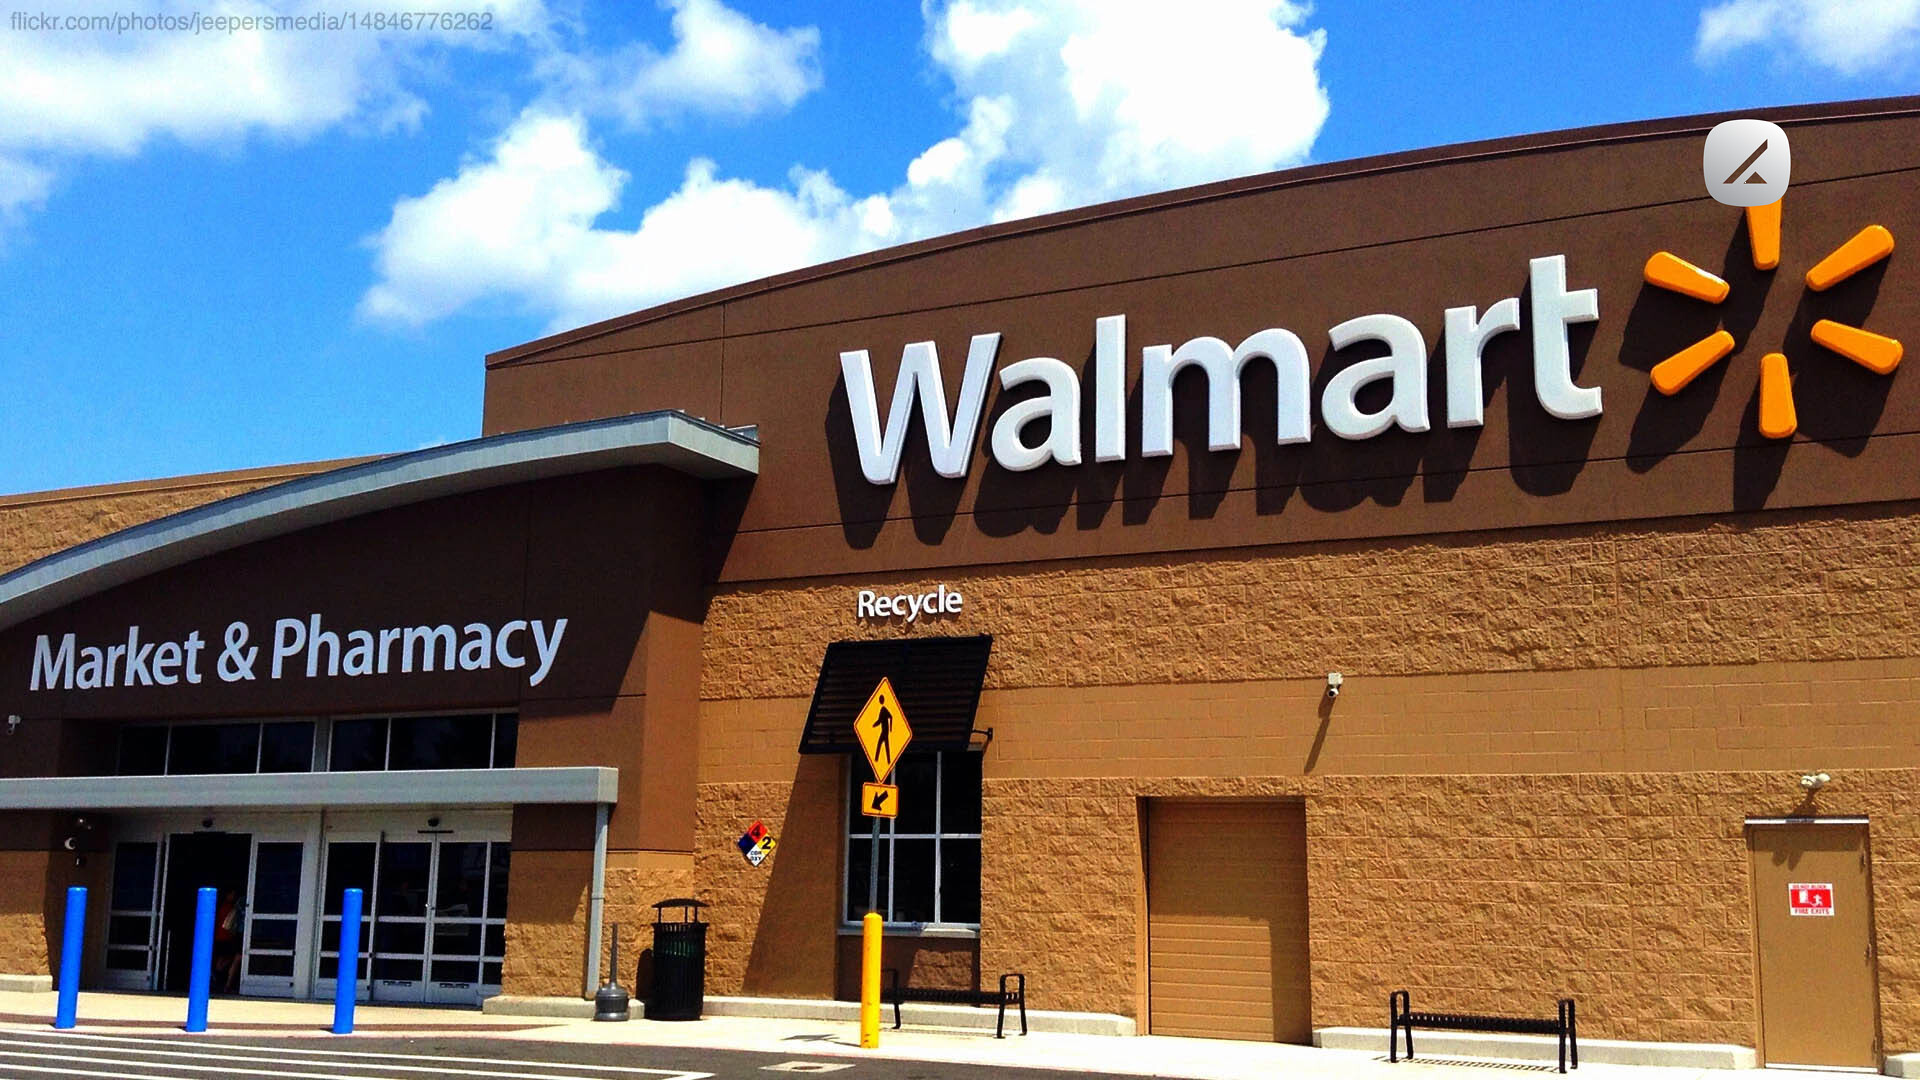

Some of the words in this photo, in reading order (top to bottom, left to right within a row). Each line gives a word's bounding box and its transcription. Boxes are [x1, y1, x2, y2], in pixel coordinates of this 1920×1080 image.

[839, 254, 1603, 485] Walmart
[858, 584, 963, 622] Recycle
[29, 626, 205, 692] Market
[215, 621, 259, 682] &
[271, 613, 569, 687] Pharmacy
[762, 836, 772, 849] 2
